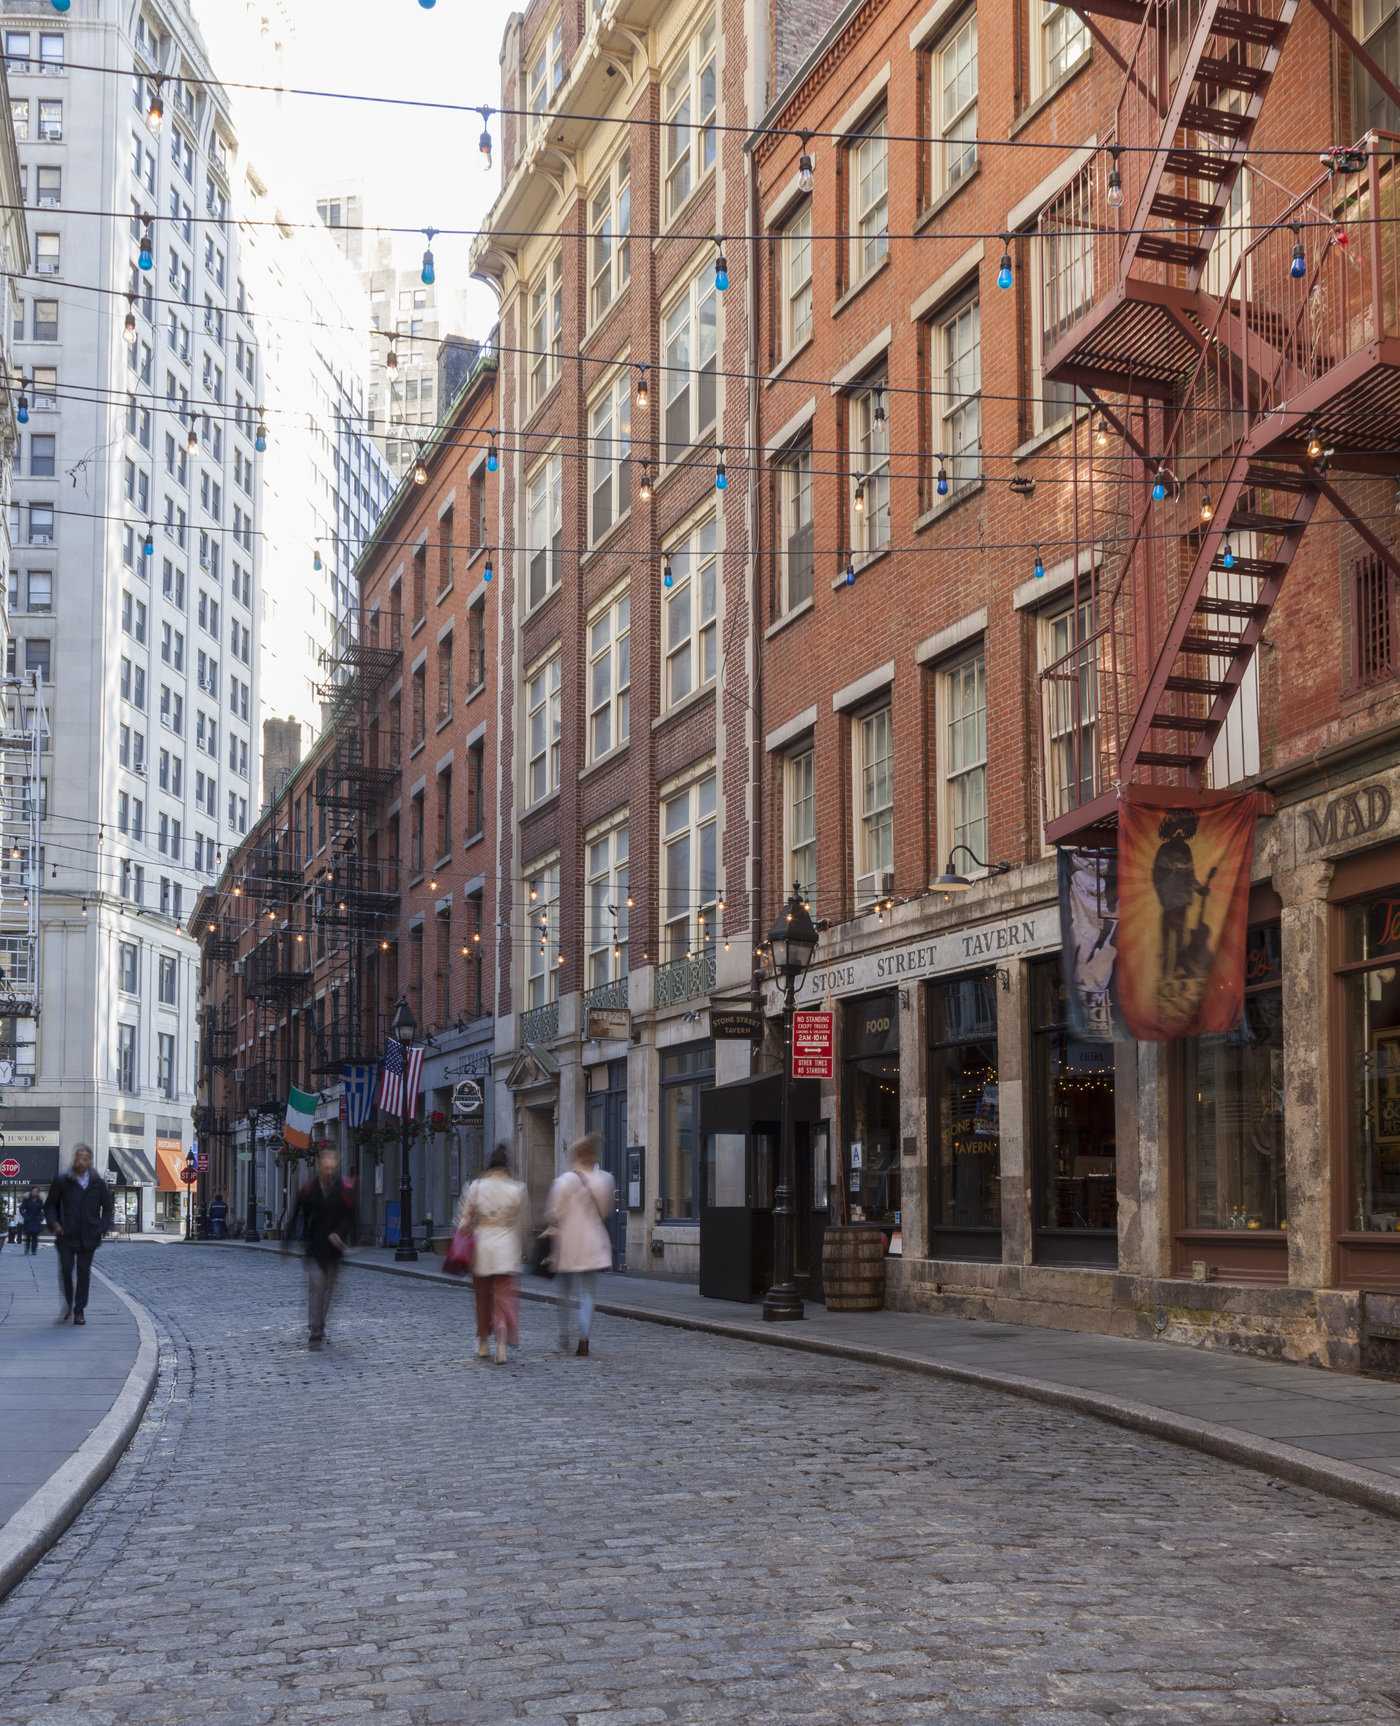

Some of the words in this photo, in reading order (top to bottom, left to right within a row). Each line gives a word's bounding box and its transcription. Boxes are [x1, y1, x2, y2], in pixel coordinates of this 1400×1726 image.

[1303, 784, 1392, 853] MAD
[811, 966, 856, 994] STONE
[876, 945, 938, 978] STREET
[961, 920, 1036, 958] TAVERN
[724, 1026, 751, 1034] TAVERN
[865, 1017, 890, 1033] FOOD
[853, 1145, 860, 1161] A
[954, 1141, 993, 1154] TAVERN
[1, 1164, 18, 1172] STOP
